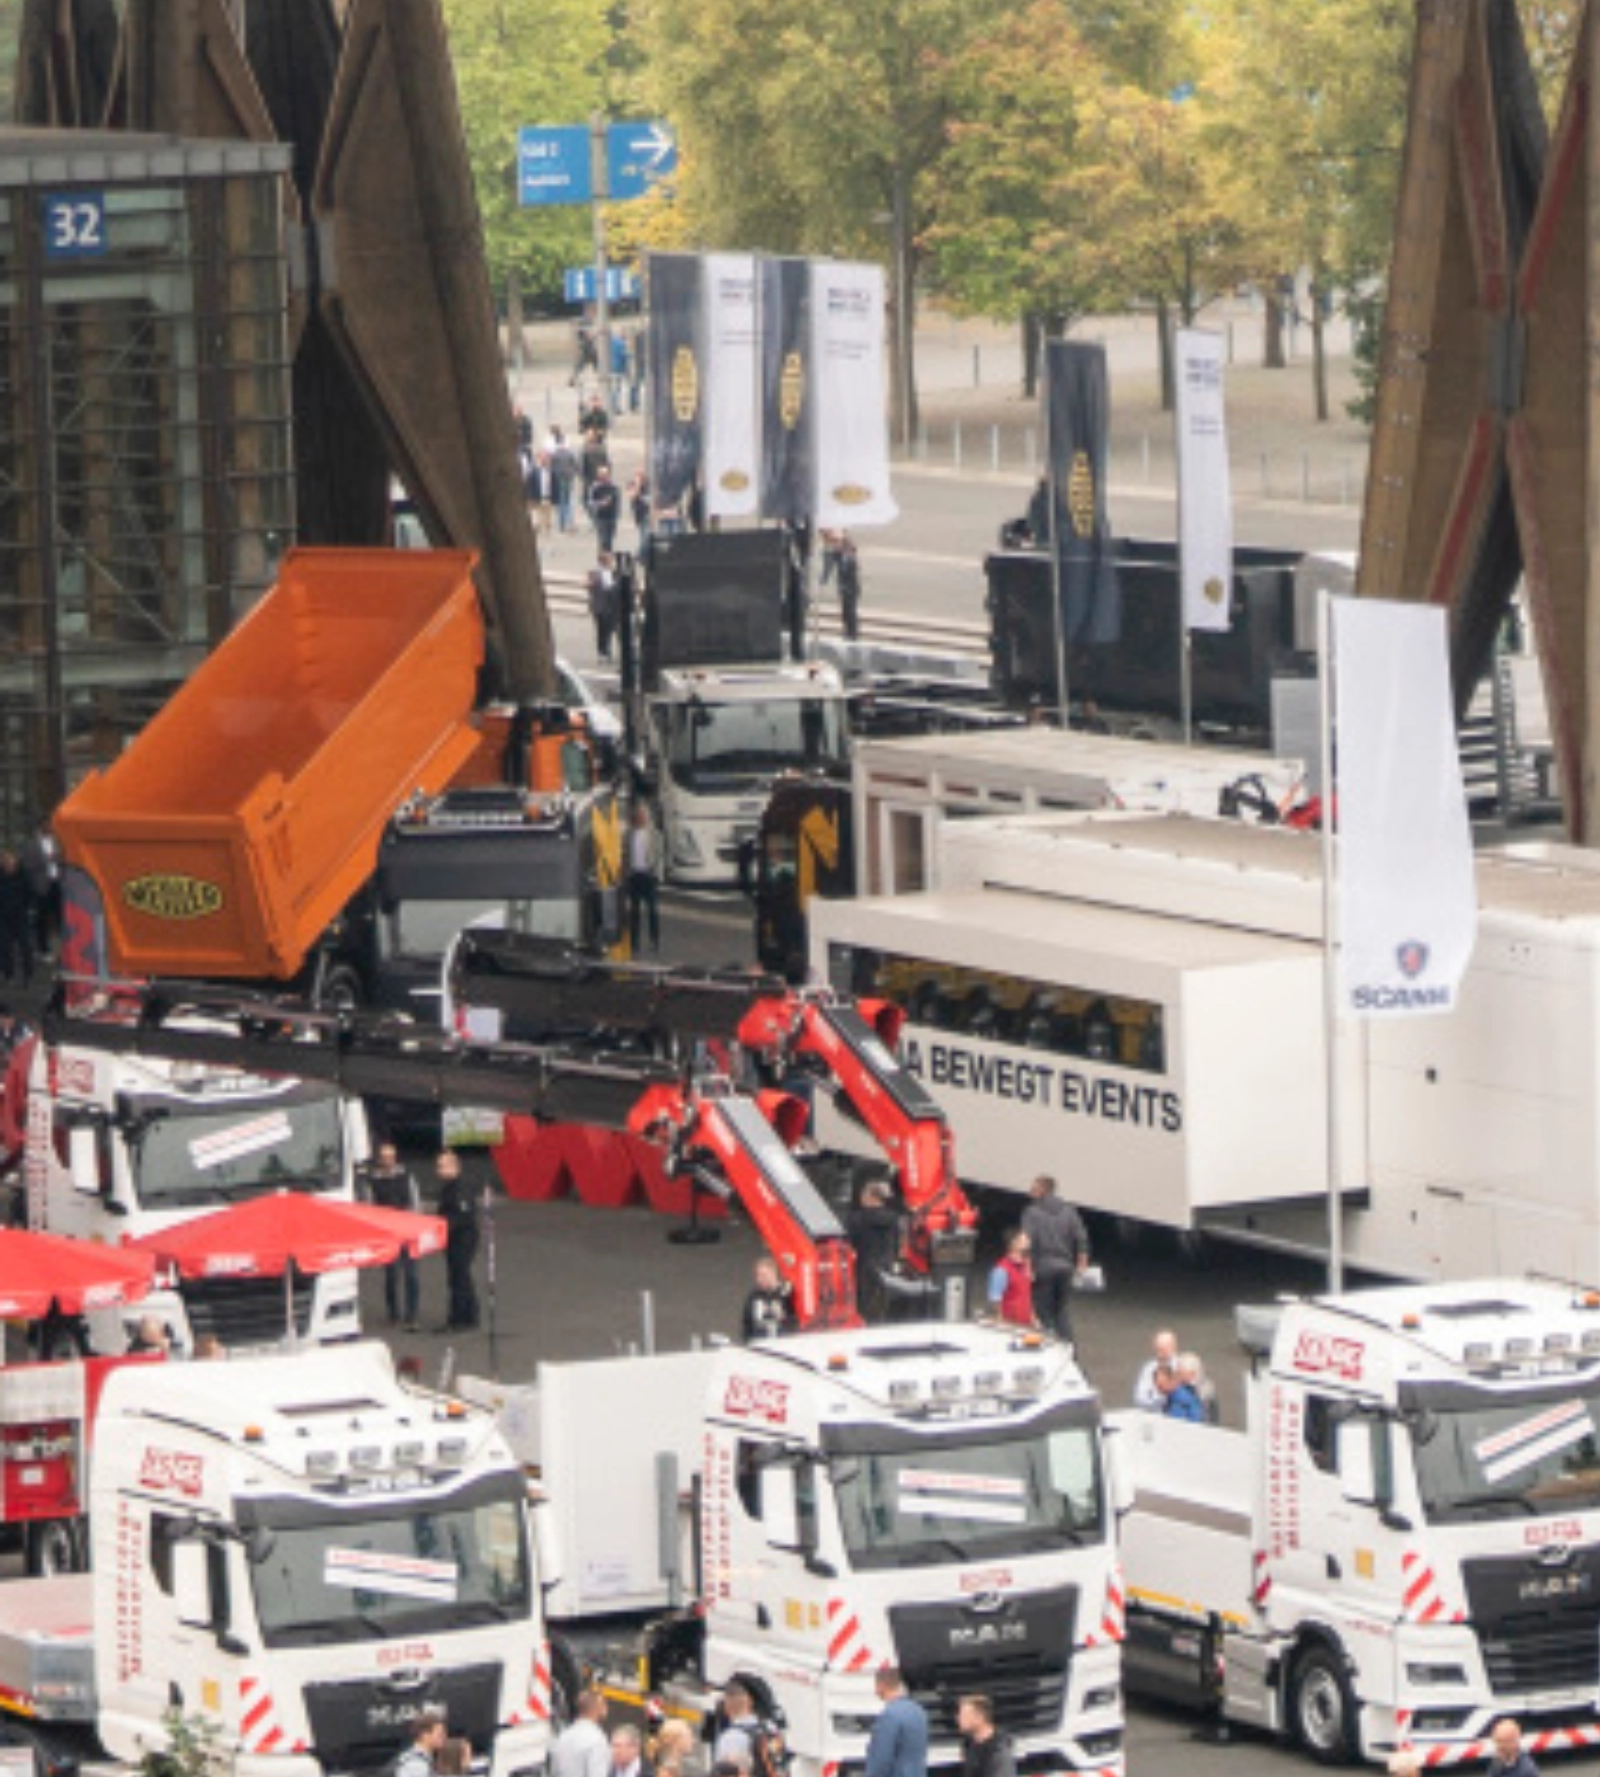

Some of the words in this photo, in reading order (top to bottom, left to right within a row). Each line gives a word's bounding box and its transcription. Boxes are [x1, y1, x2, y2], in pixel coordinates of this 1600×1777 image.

[52, 204, 101, 246] 32
[930, 1044, 1053, 1106] BEWEGT
[1061, 1072, 1183, 1133] EVENTS
